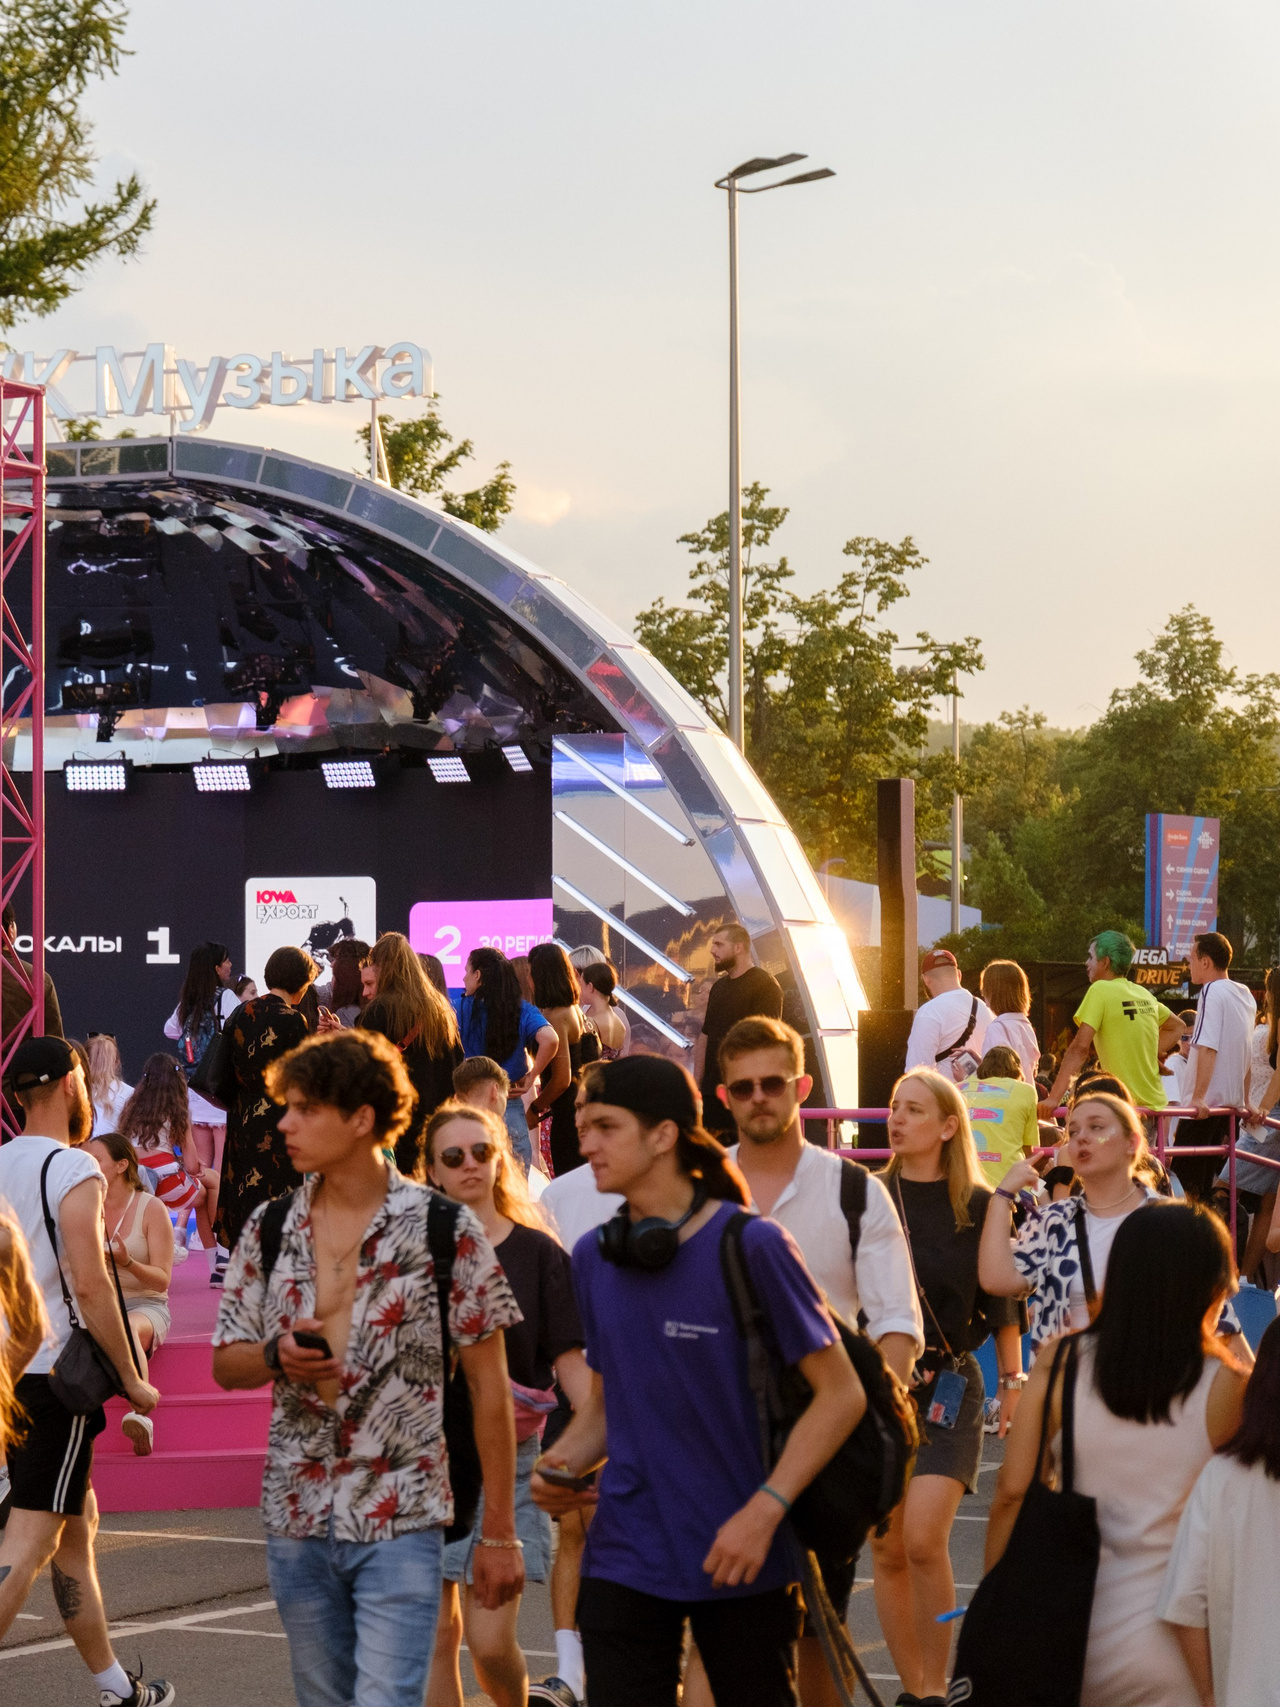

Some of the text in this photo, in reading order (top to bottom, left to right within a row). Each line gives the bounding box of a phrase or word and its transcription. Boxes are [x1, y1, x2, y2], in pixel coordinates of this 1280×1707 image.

[96, 341, 432, 432] Музыка
[256, 890, 298, 904] IOWA
[256, 904, 319, 924] EXPORT
[10, 935, 122, 953] ОКАЛЫ
[145, 926, 180, 964] 1
[434, 925, 462, 965] 2
[1136, 968, 1181, 985] DRIVE
